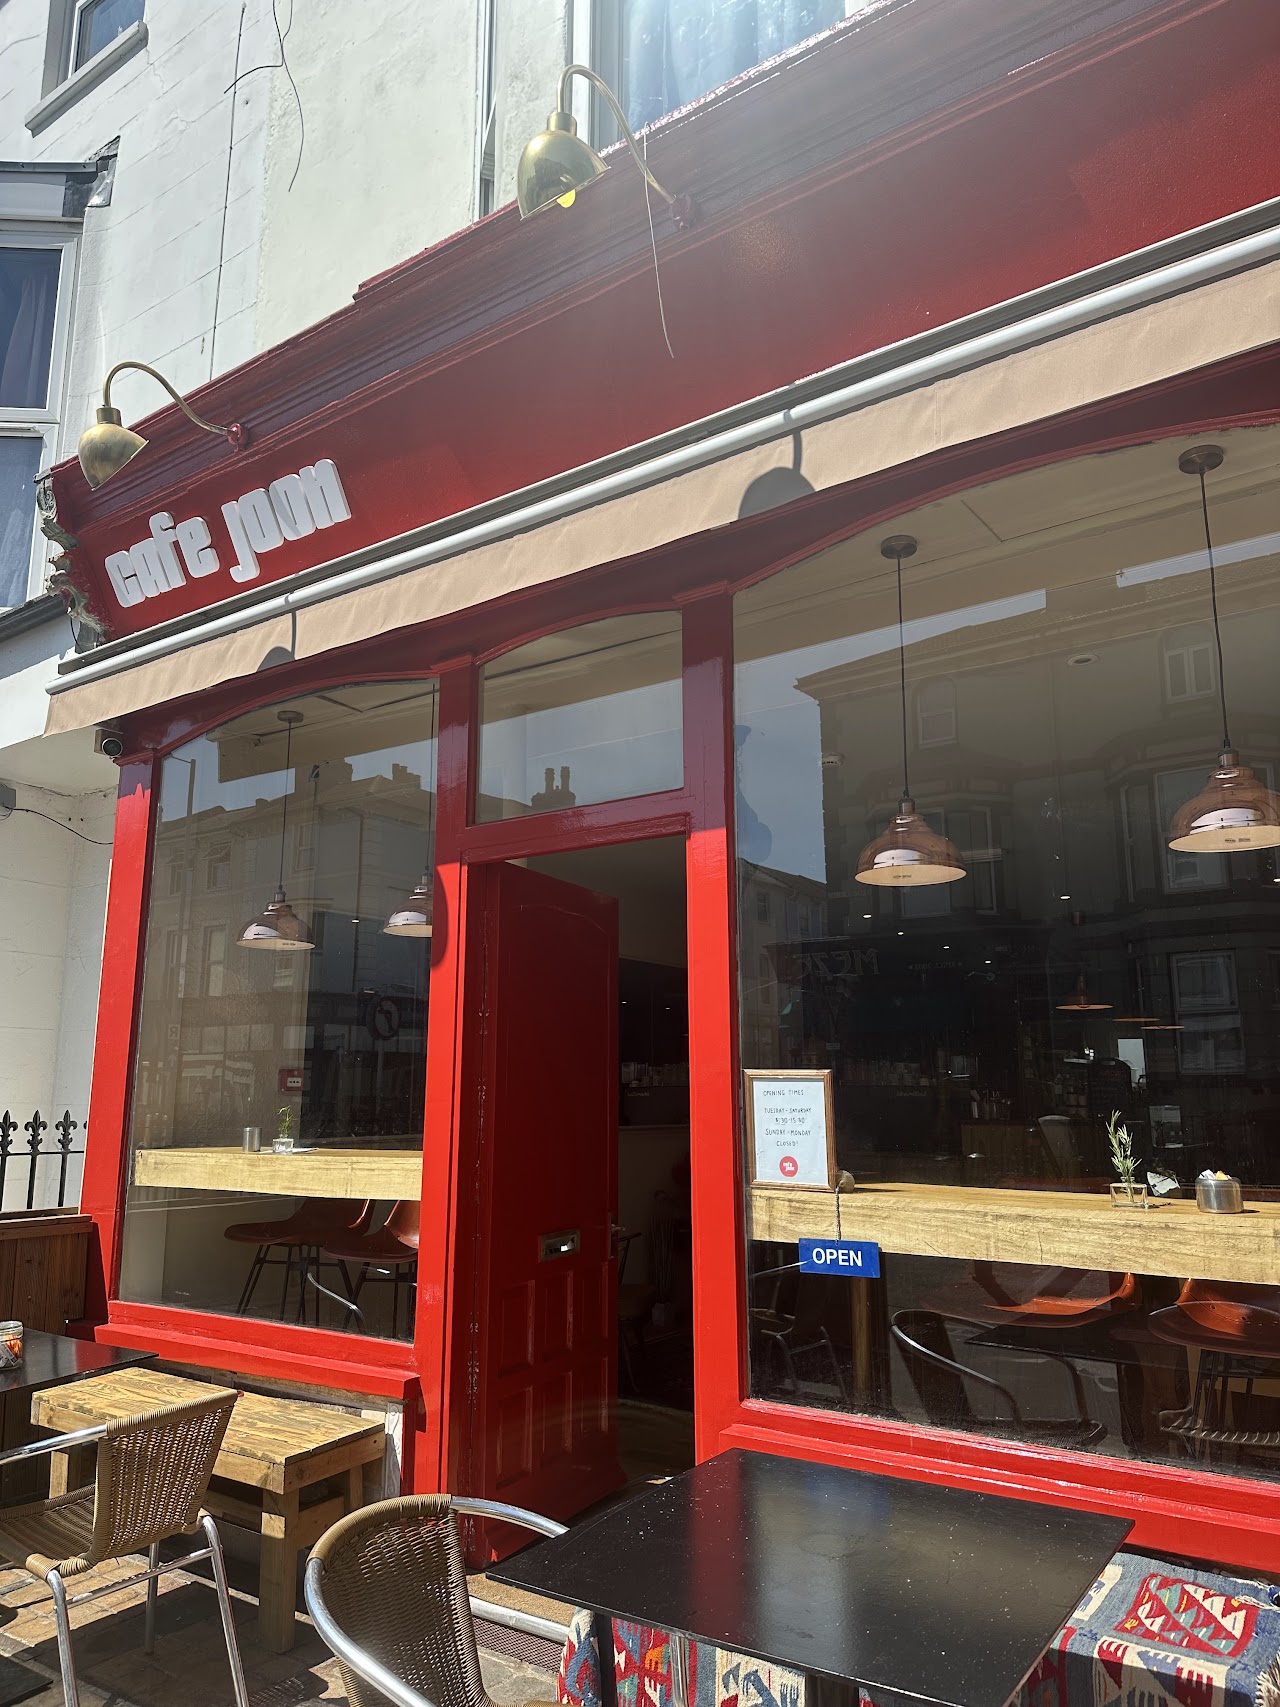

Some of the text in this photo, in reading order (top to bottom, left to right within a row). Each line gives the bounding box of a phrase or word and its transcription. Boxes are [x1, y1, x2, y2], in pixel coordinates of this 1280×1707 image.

[105, 459, 352, 608] cafe joon
[762, 1089, 786, 1097] OPENING
[765, 1128, 786, 1136] SUNDAY
[812, 1247, 863, 1267] OPEN
